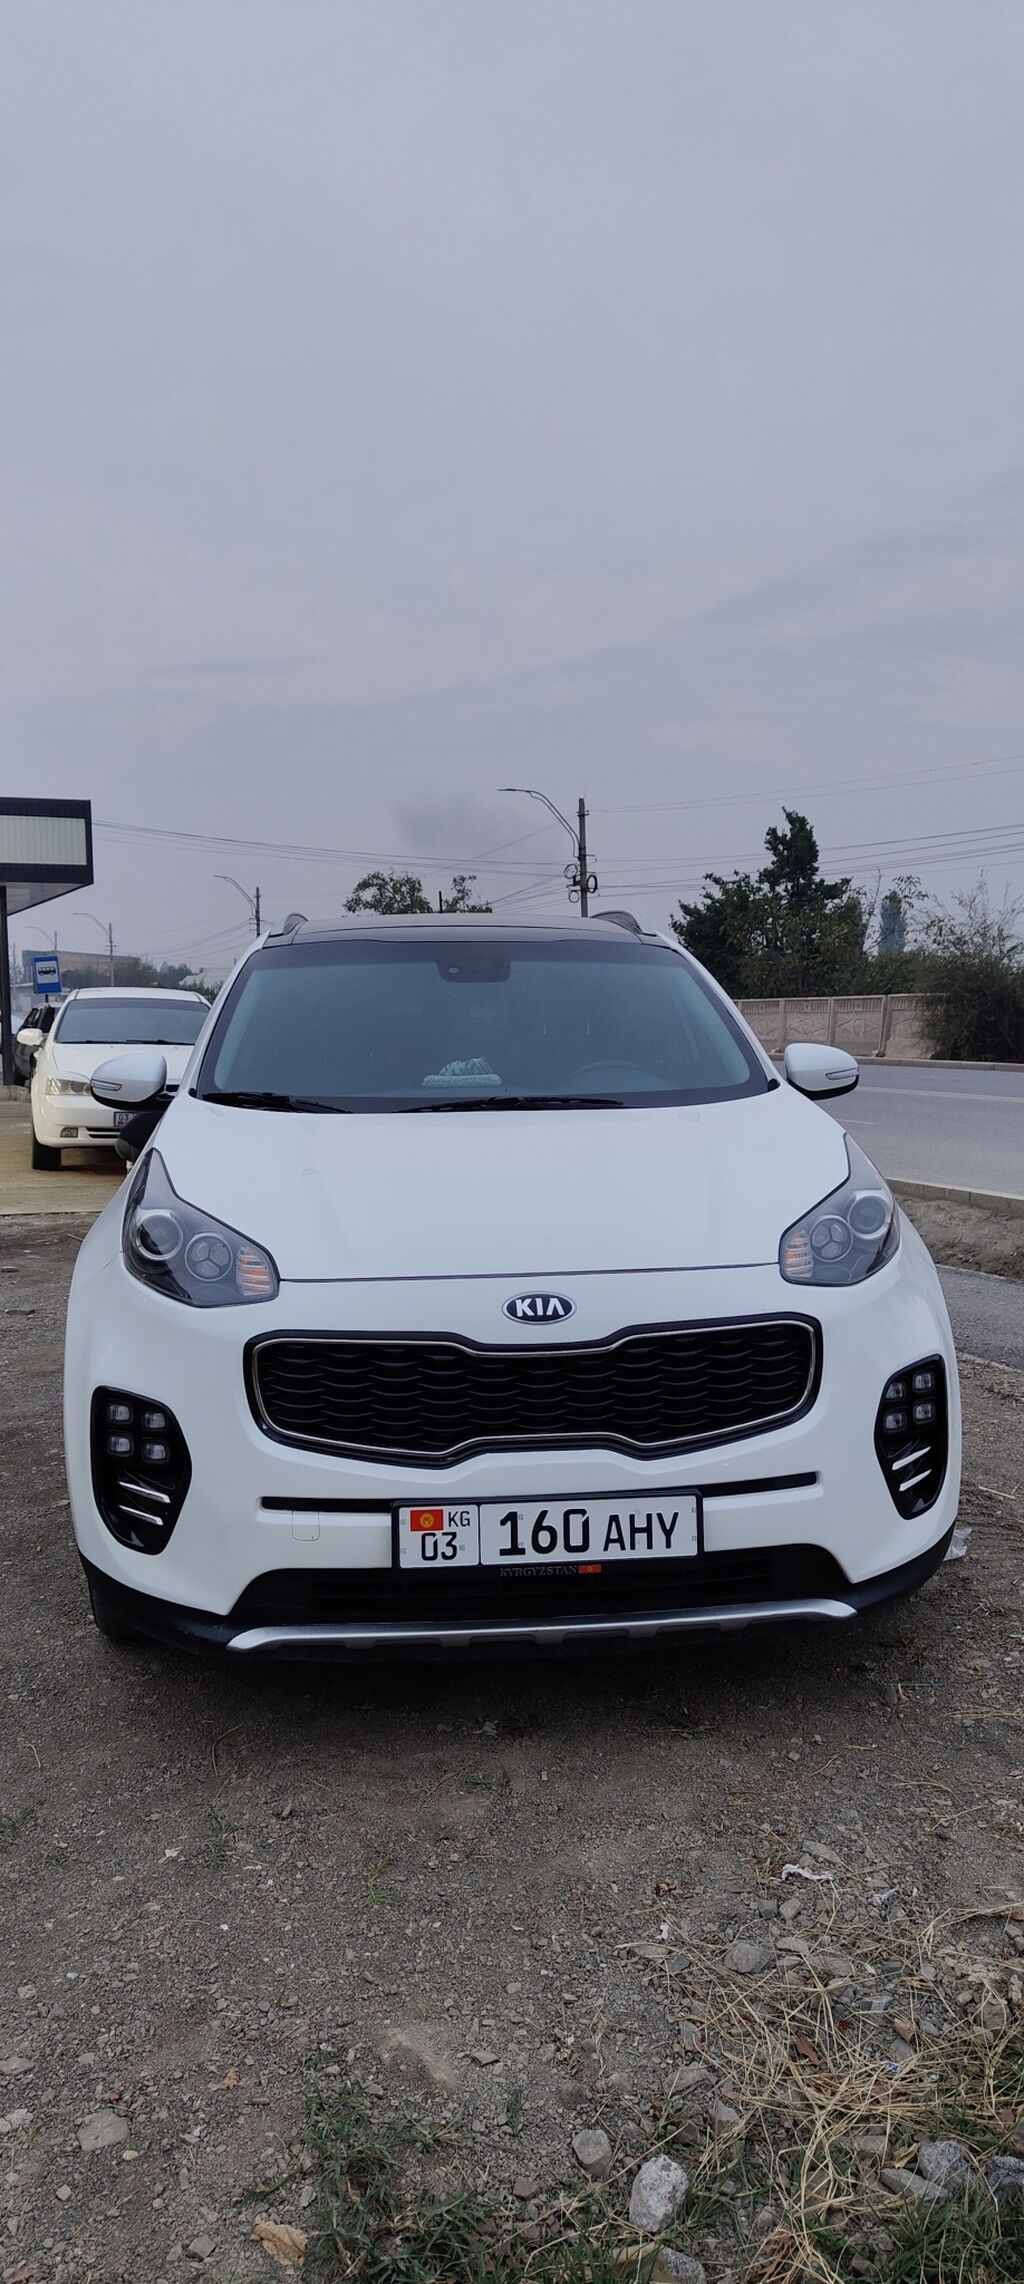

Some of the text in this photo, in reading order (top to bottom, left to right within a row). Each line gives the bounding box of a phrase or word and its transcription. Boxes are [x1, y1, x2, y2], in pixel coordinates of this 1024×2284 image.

[515, 1297, 565, 1317] KIA
[448, 1511, 470, 1527] KG
[499, 1508, 679, 1556] 160 AHY
[421, 1532, 457, 1561] 03
[500, 1565, 577, 1577] KYRGYZSTAN
